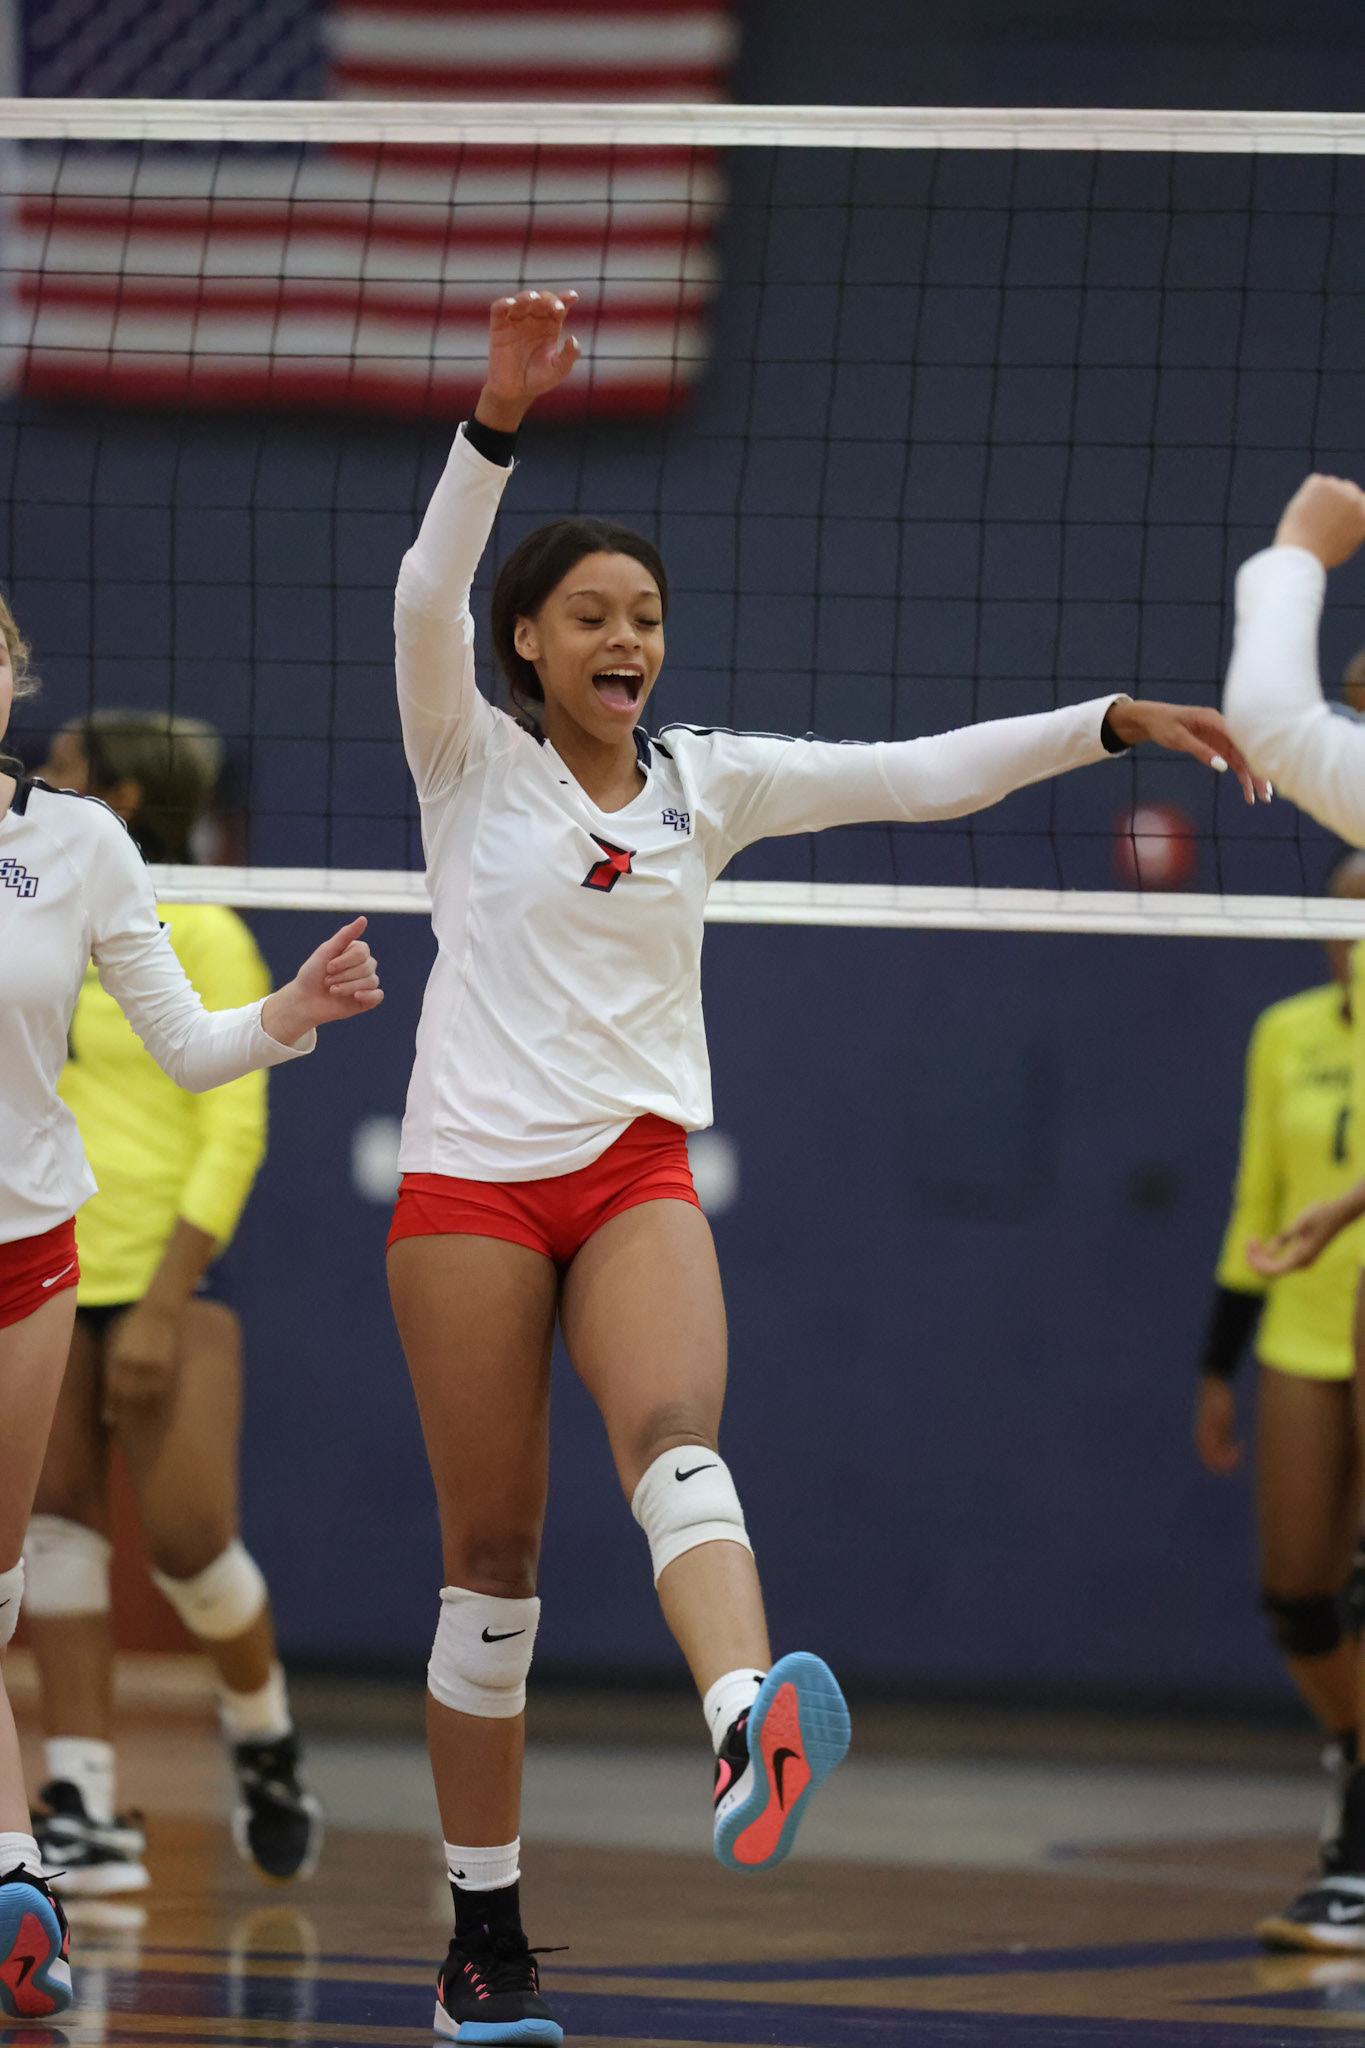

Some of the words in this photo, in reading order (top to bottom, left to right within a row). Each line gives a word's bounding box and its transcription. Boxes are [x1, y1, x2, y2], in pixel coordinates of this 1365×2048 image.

[662, 808, 690, 835] SB
[0, 858, 39, 897] SBA
[580, 832, 637, 893] 7
